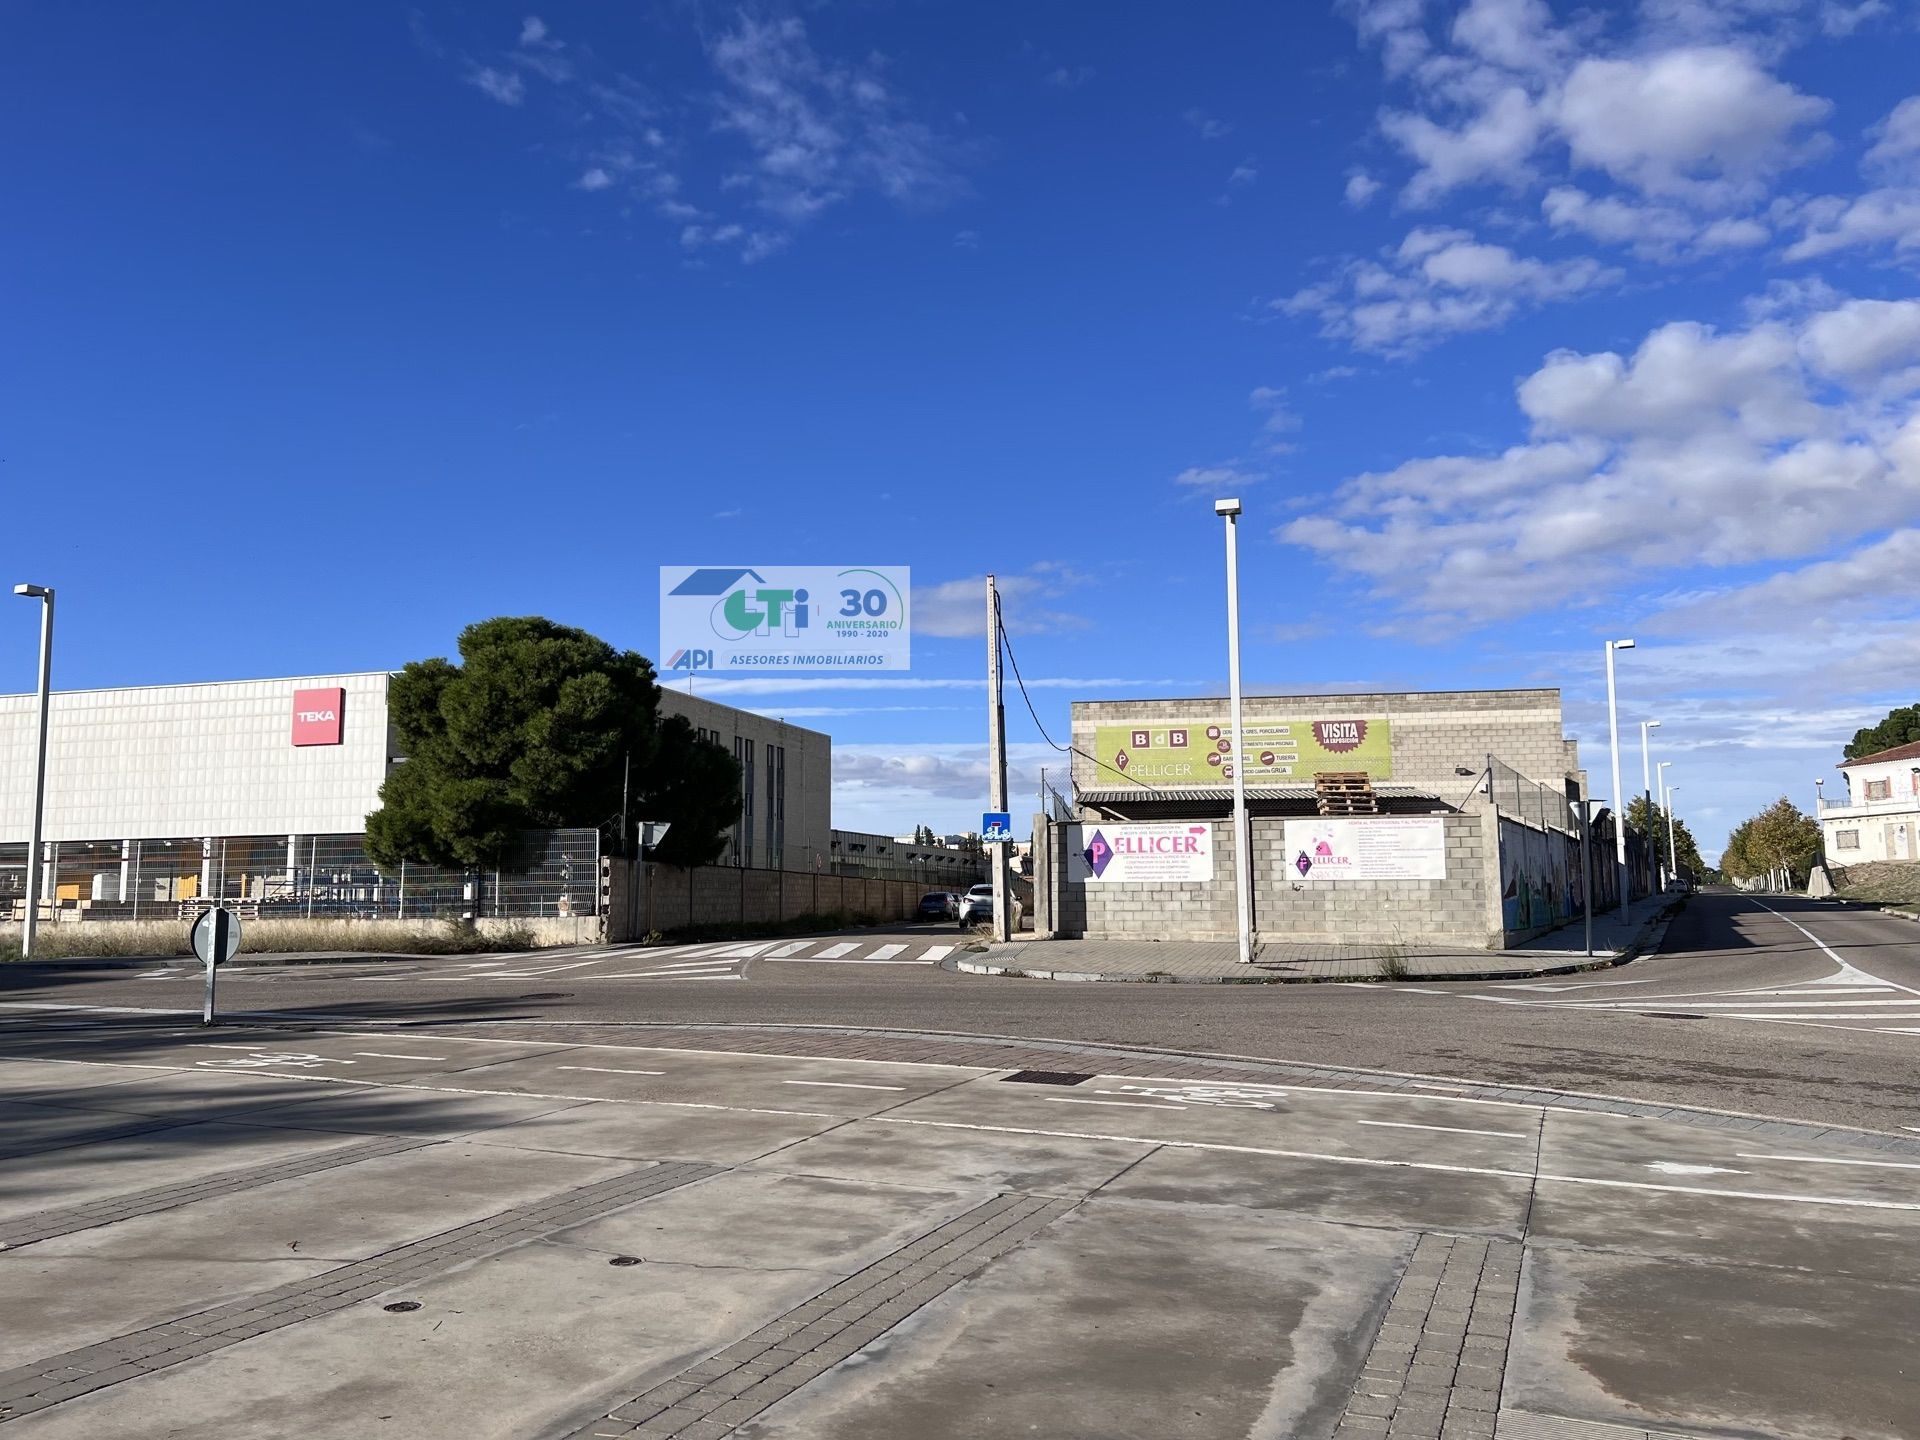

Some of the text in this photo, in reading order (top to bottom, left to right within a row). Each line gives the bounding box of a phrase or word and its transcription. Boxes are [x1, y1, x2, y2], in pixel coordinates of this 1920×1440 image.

[297, 710, 336, 723] TEKA
[1321, 722, 1359, 738] VISITA
[1129, 763, 1192, 777] PELLICER
